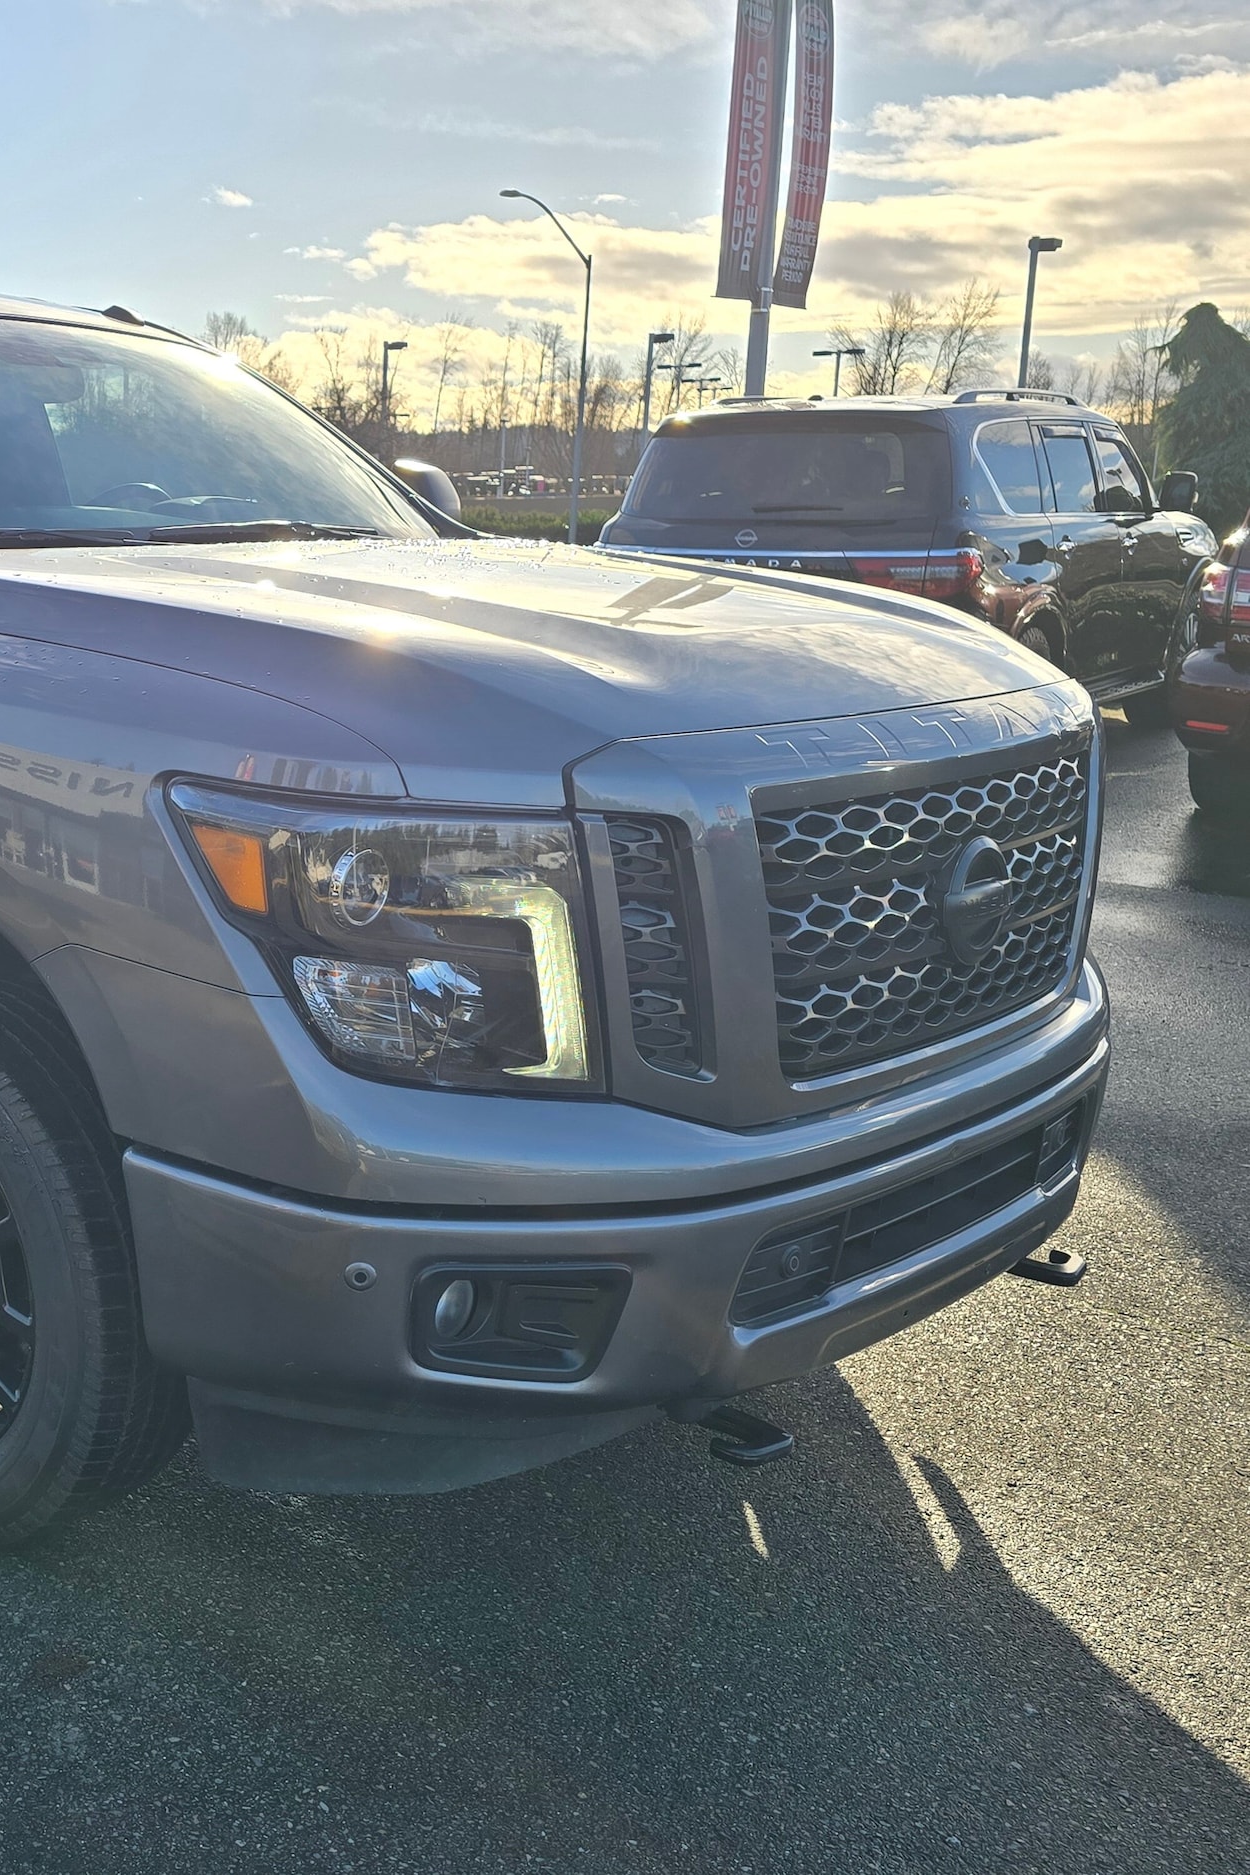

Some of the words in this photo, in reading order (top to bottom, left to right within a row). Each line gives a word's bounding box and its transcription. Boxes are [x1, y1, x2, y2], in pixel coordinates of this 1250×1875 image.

[731, 72, 756, 251] CERTIFIED
[740, 55, 768, 272] PRE-OWNED
[1230, 632, 1250, 644] AR
